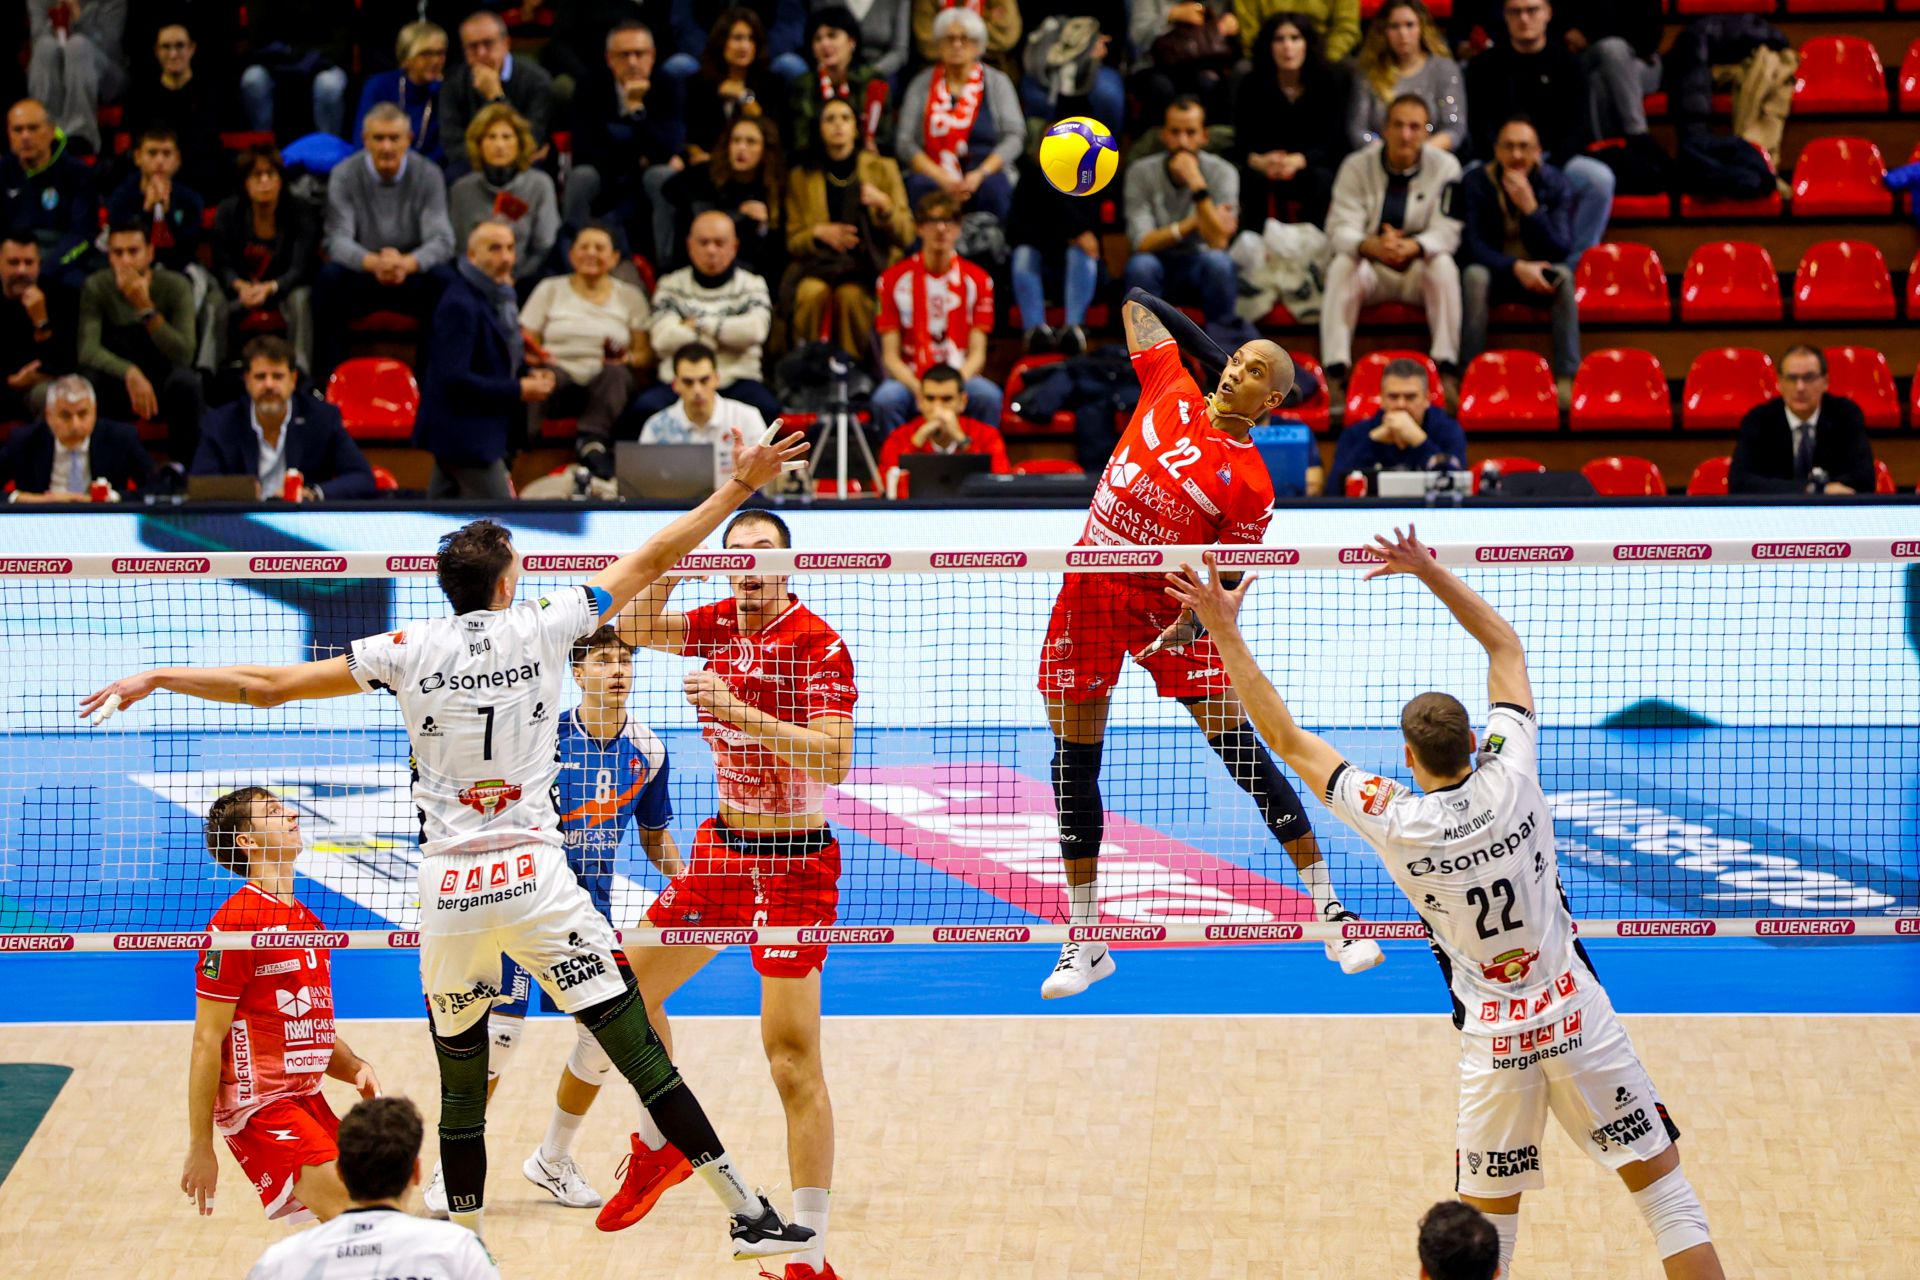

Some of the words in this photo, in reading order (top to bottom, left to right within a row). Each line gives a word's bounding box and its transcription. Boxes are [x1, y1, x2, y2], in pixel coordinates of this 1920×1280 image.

[1157, 437, 1202, 480] 22
[1130, 482, 1191, 526] PIACENZA
[1137, 473, 1176, 507] BANCA
[1178, 504, 1195, 517] DI
[1115, 501, 1141, 524] GAS
[1142, 518, 1181, 542] SALES
[799, 554, 887, 567] BLUENERGY
[935, 553, 1023, 567] BLUENERGY
[1070, 552, 1159, 565] BLUENERGY
[1480, 548, 1569, 561] BLUENERGY
[1617, 546, 1707, 559] BLUENERGY
[1756, 544, 1846, 558] BLUENERGY
[117, 559, 206, 572] BLUENERGY
[254, 558, 343, 571] BLUENERGY
[469, 637, 491, 657] POLO
[449, 660, 541, 691] sonepar
[477, 706, 495, 761] 7
[595, 770, 612, 805] 8
[1440, 811, 1538, 875] sonepar
[441, 855, 535, 892] BAAP
[437, 878, 538, 913] bergamaschi
[1466, 877, 1524, 941] 22
[801, 929, 891, 943] BLUENERGY
[938, 928, 1026, 942] BLUENERGY
[1074, 927, 1161, 941] BLUENERGY
[1210, 925, 1298, 939] BLUENERGY
[1621, 922, 1711, 935] BLUENERGY
[1760, 920, 1850, 933] BLUENERGY
[118, 935, 207, 949] BLUENERGY
[255, 934, 345, 948] BLUENERGY
[665, 931, 754, 944] BLUENERGY
[550, 952, 601, 978] TECNO
[556, 959, 606, 991] CRANE
[1481, 974, 1574, 1022] BAAP
[313, 1018, 329, 1031] GAS
[1494, 1011, 1580, 1052] BAAP
[234, 1025, 252, 1102] BLUENERGY
[1600, 1108, 1646, 1137] ECNO
[1486, 1144, 1539, 1165] TECNO
[1486, 1157, 1540, 1178] CRANE
